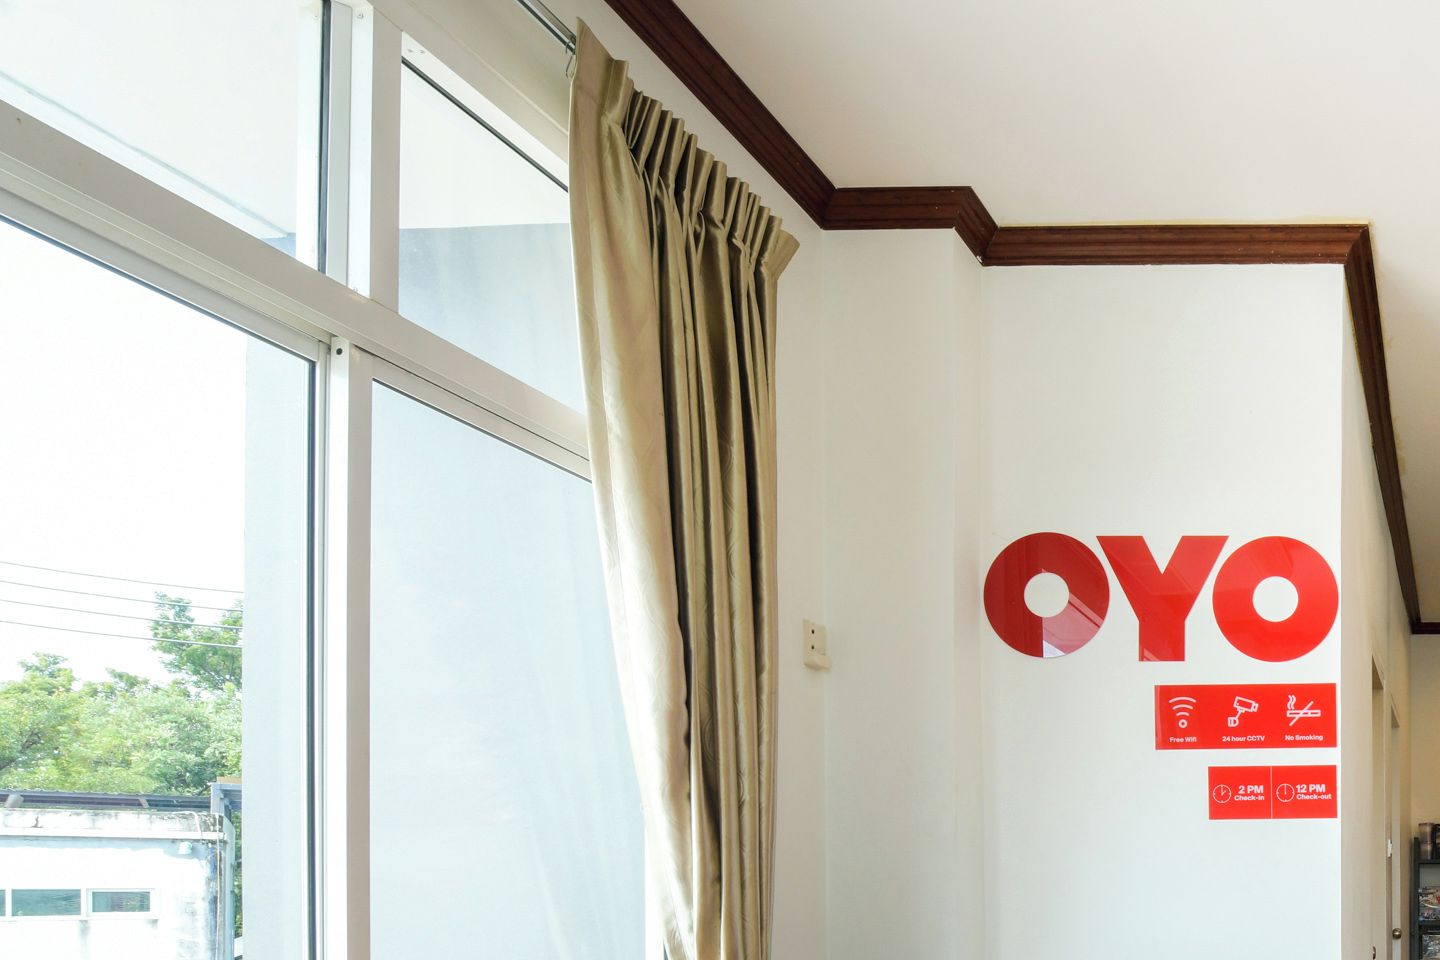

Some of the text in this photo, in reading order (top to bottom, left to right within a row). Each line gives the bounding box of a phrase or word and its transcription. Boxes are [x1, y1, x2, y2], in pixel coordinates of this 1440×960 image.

[984, 532, 1339, 662] OYO
[1238, 785, 1264, 794] 2 PM
[1296, 784, 1325, 793] 12 PM
